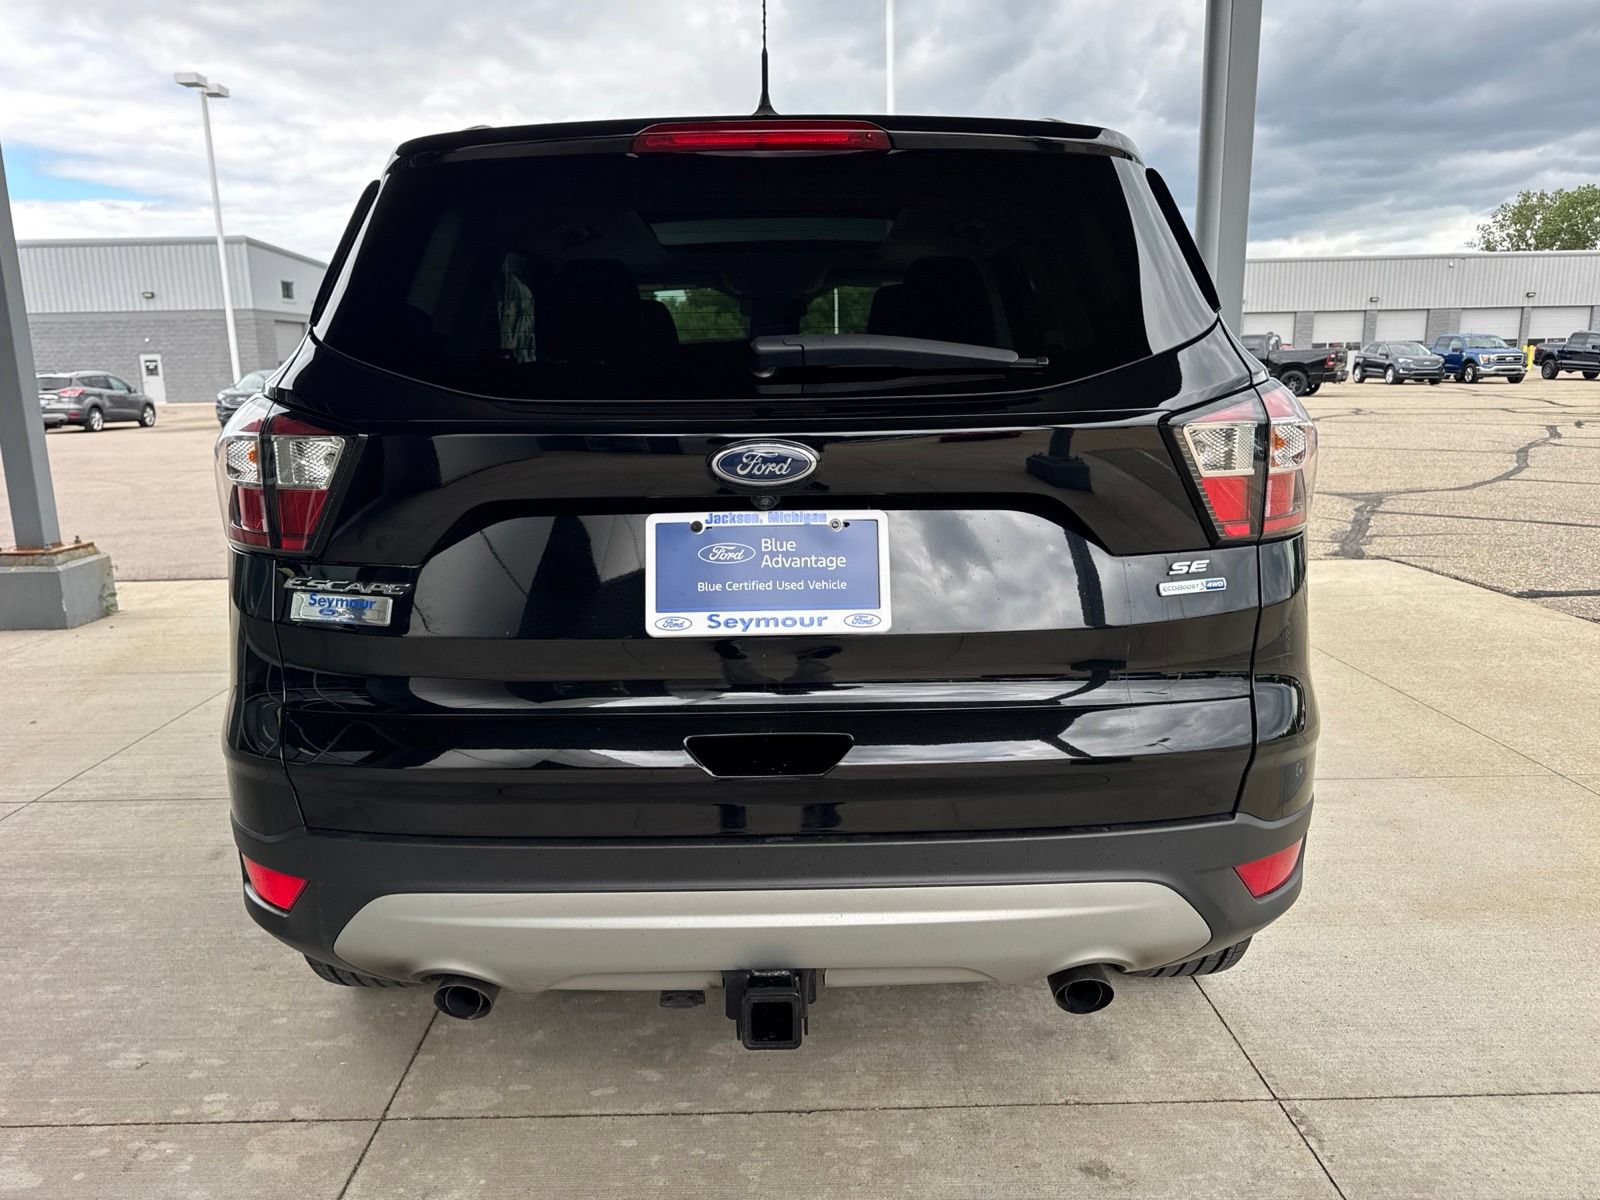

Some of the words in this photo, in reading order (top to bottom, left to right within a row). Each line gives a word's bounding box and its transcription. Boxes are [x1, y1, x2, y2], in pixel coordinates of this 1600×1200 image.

[736, 450, 792, 475] Ford
[705, 512, 763, 525] Jackson,
[767, 511, 827, 525] Michigan
[761, 538, 797, 552] Blue
[708, 546, 745, 562] Ford
[760, 553, 847, 570] Advantage
[1167, 559, 1210, 576] SE
[283, 576, 410, 595] ESCAPE
[697, 582, 722, 592] Blue
[725, 580, 773, 591] Certified
[776, 580, 804, 590] Used
[807, 579, 848, 590] Vehicle
[308, 591, 376, 609] Seymour
[662, 618, 686, 630] Ford
[706, 613, 828, 632] Seymour
[851, 615, 874, 626] Ford
